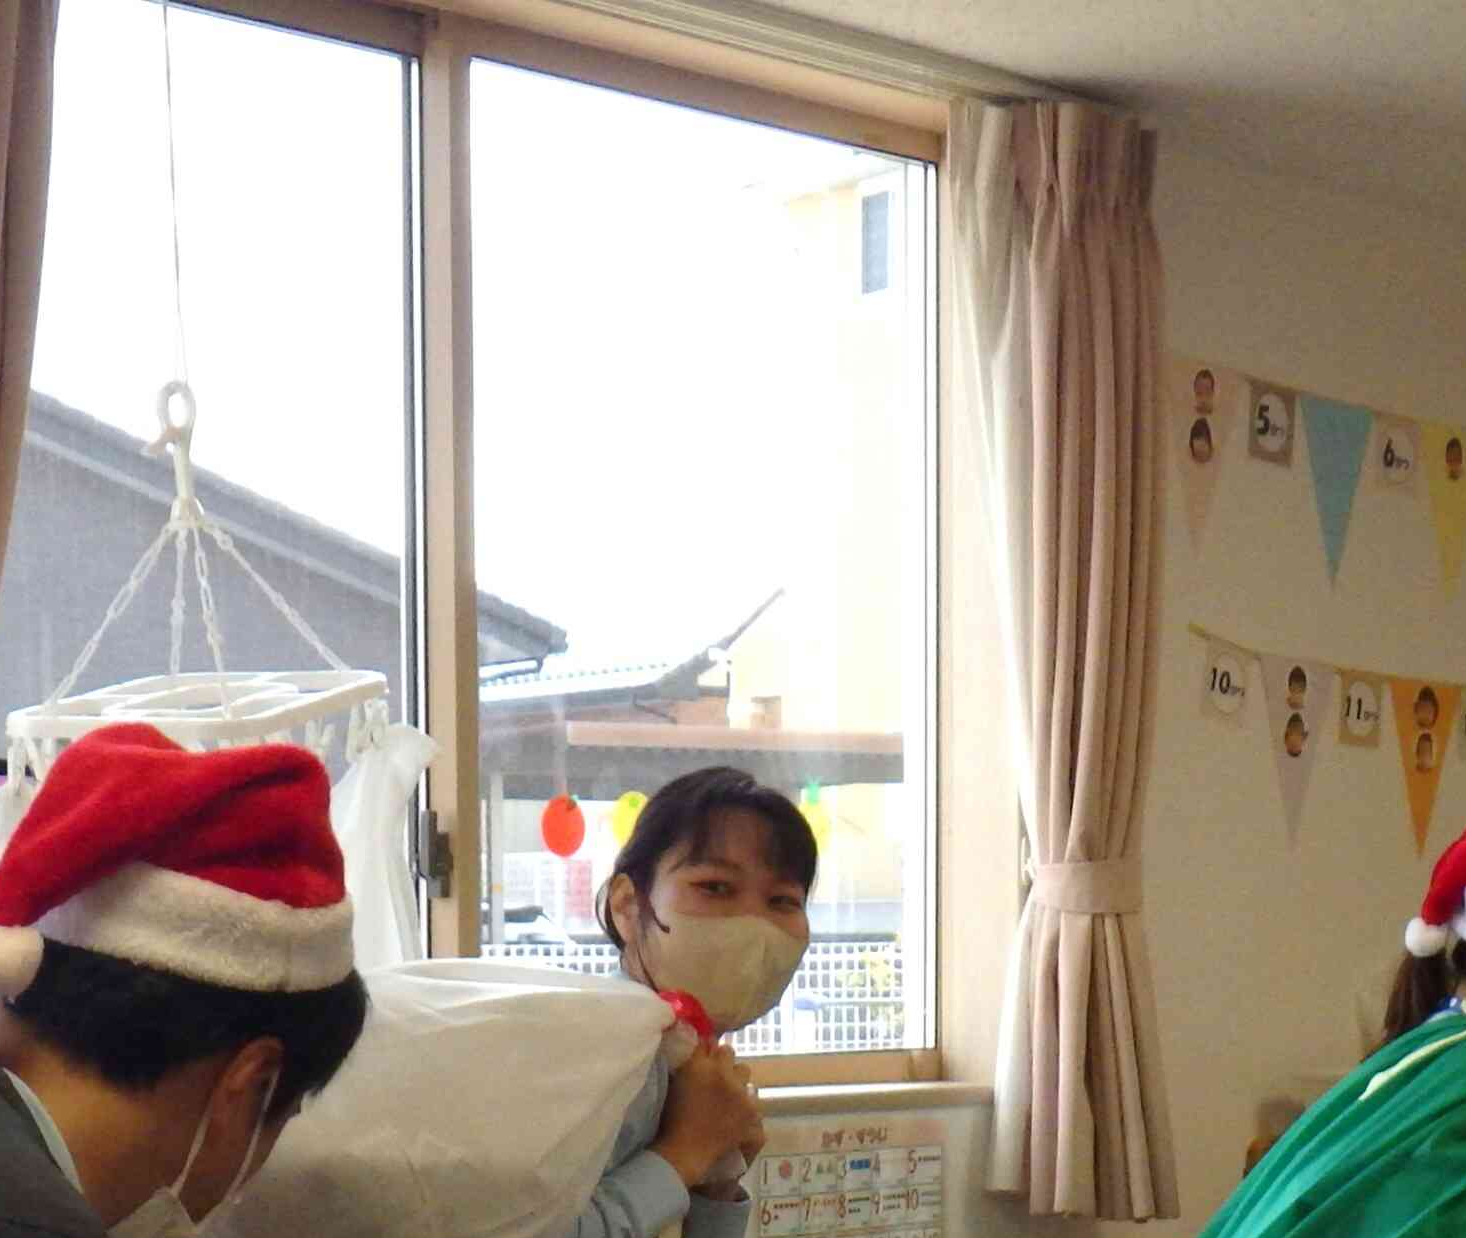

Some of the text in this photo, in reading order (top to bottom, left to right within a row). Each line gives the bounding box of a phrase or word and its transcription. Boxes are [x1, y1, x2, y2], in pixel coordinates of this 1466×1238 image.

[763, 1159, 770, 1185] 1
[803, 1157, 813, 1183] 2
[871, 1152, 881, 1175] 4
[908, 1150, 917, 1174] 5
[760, 1188, 919, 1226] 6 7 8 9 10
